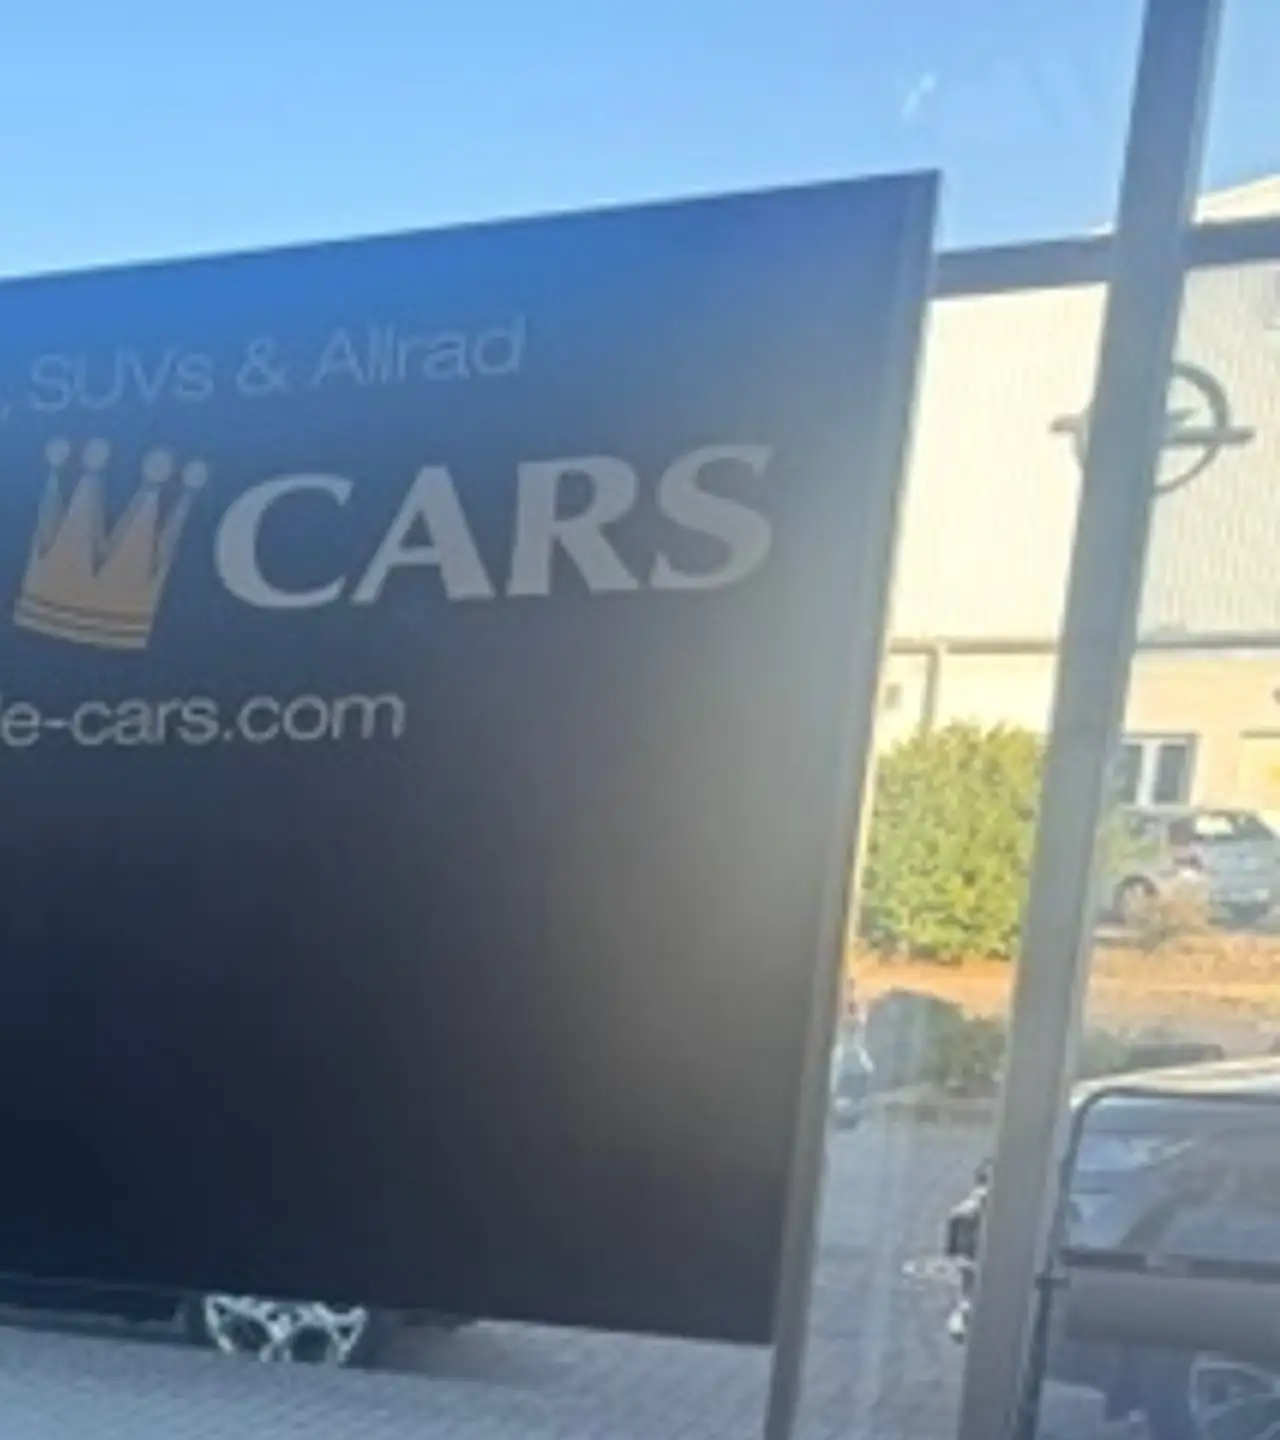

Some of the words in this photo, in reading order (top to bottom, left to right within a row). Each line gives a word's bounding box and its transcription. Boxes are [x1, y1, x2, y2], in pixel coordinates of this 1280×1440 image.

[27, 343, 215, 411] SUVs
[236, 337, 288, 396] &
[310, 315, 527, 385] Allrad
[213, 444, 773, 608] CARS
